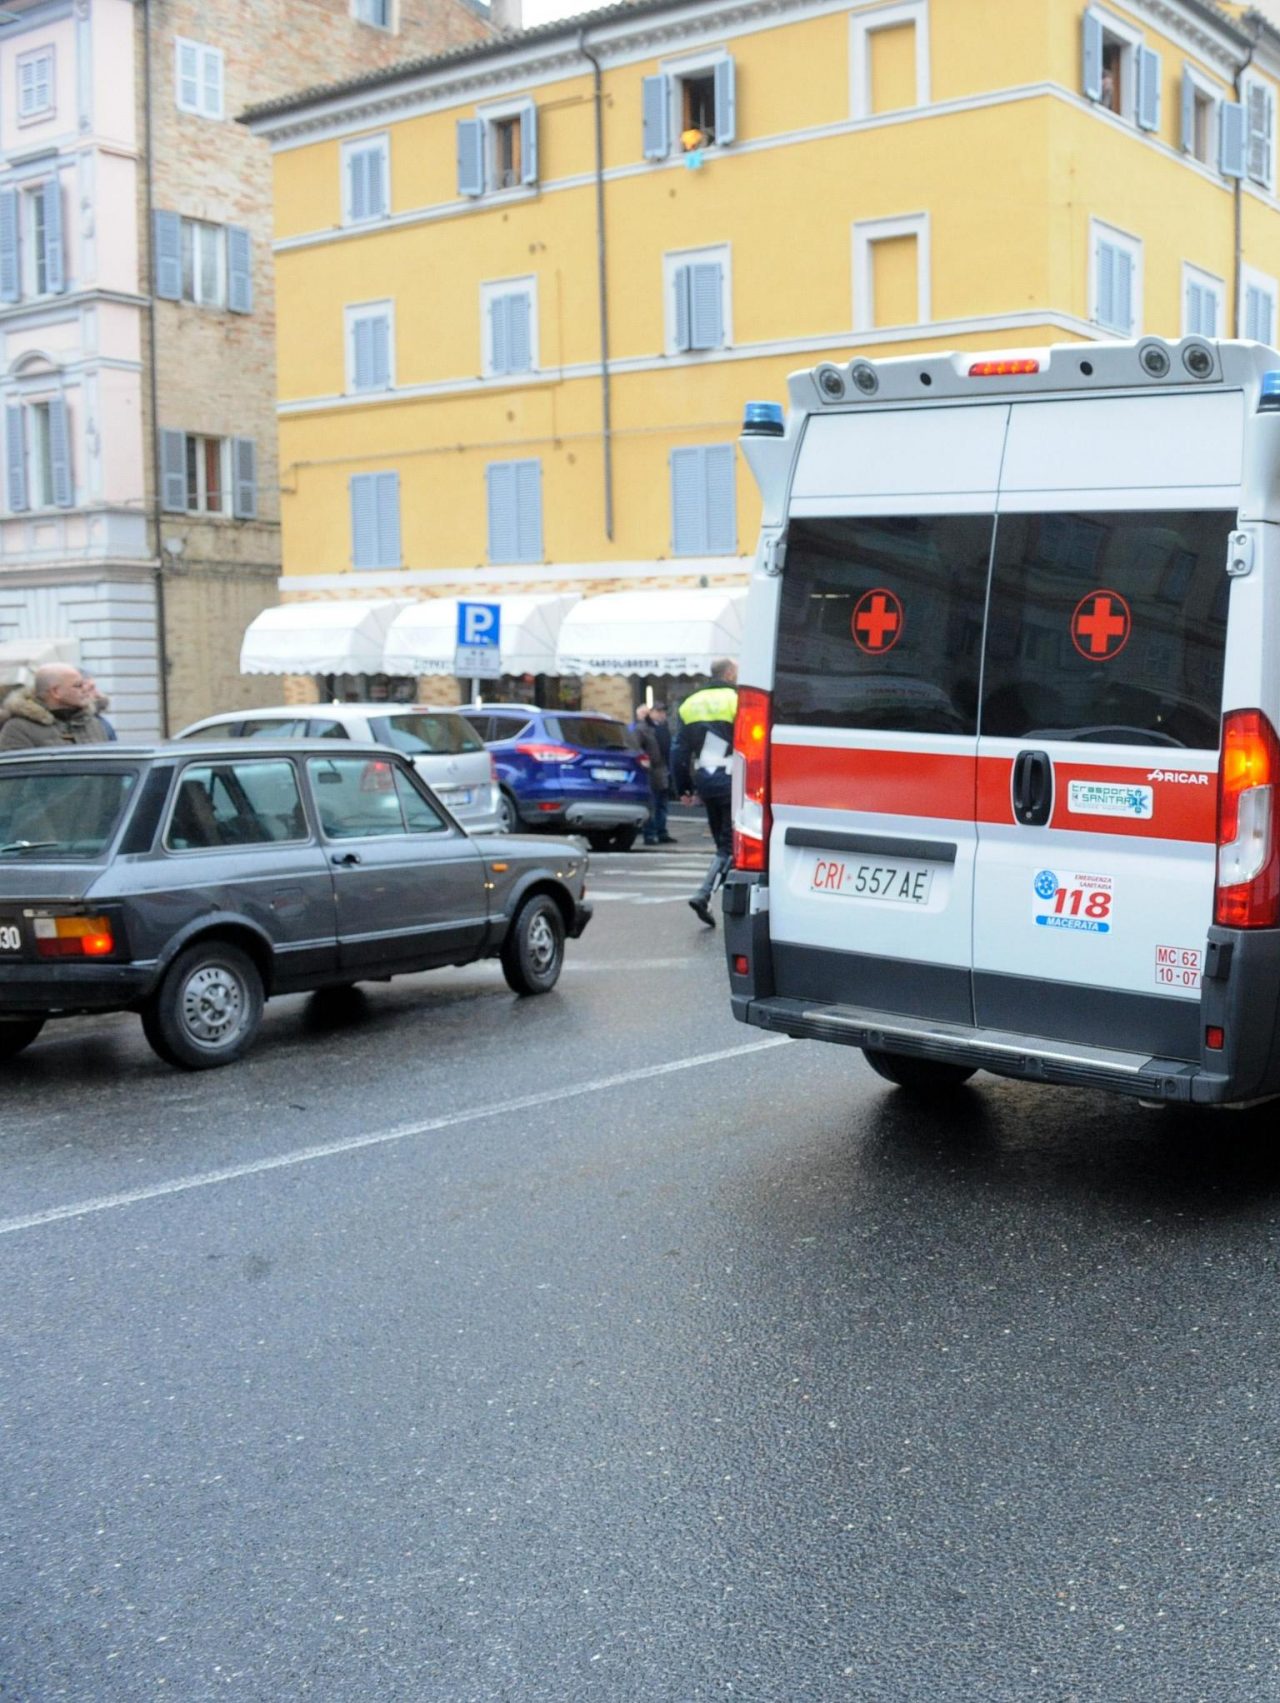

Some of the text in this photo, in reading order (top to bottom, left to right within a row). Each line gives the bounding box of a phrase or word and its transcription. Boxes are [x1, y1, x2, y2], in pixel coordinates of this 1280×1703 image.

[465, 605, 494, 643] P
[1146, 769, 1209, 785] ARICAR
[813, 861, 845, 890] CRI
[1055, 888, 1112, 919] 118
[1046, 916, 1100, 931] MACERATA
[0, 926, 21, 950] 30
[1158, 948, 1198, 967] MC 62
